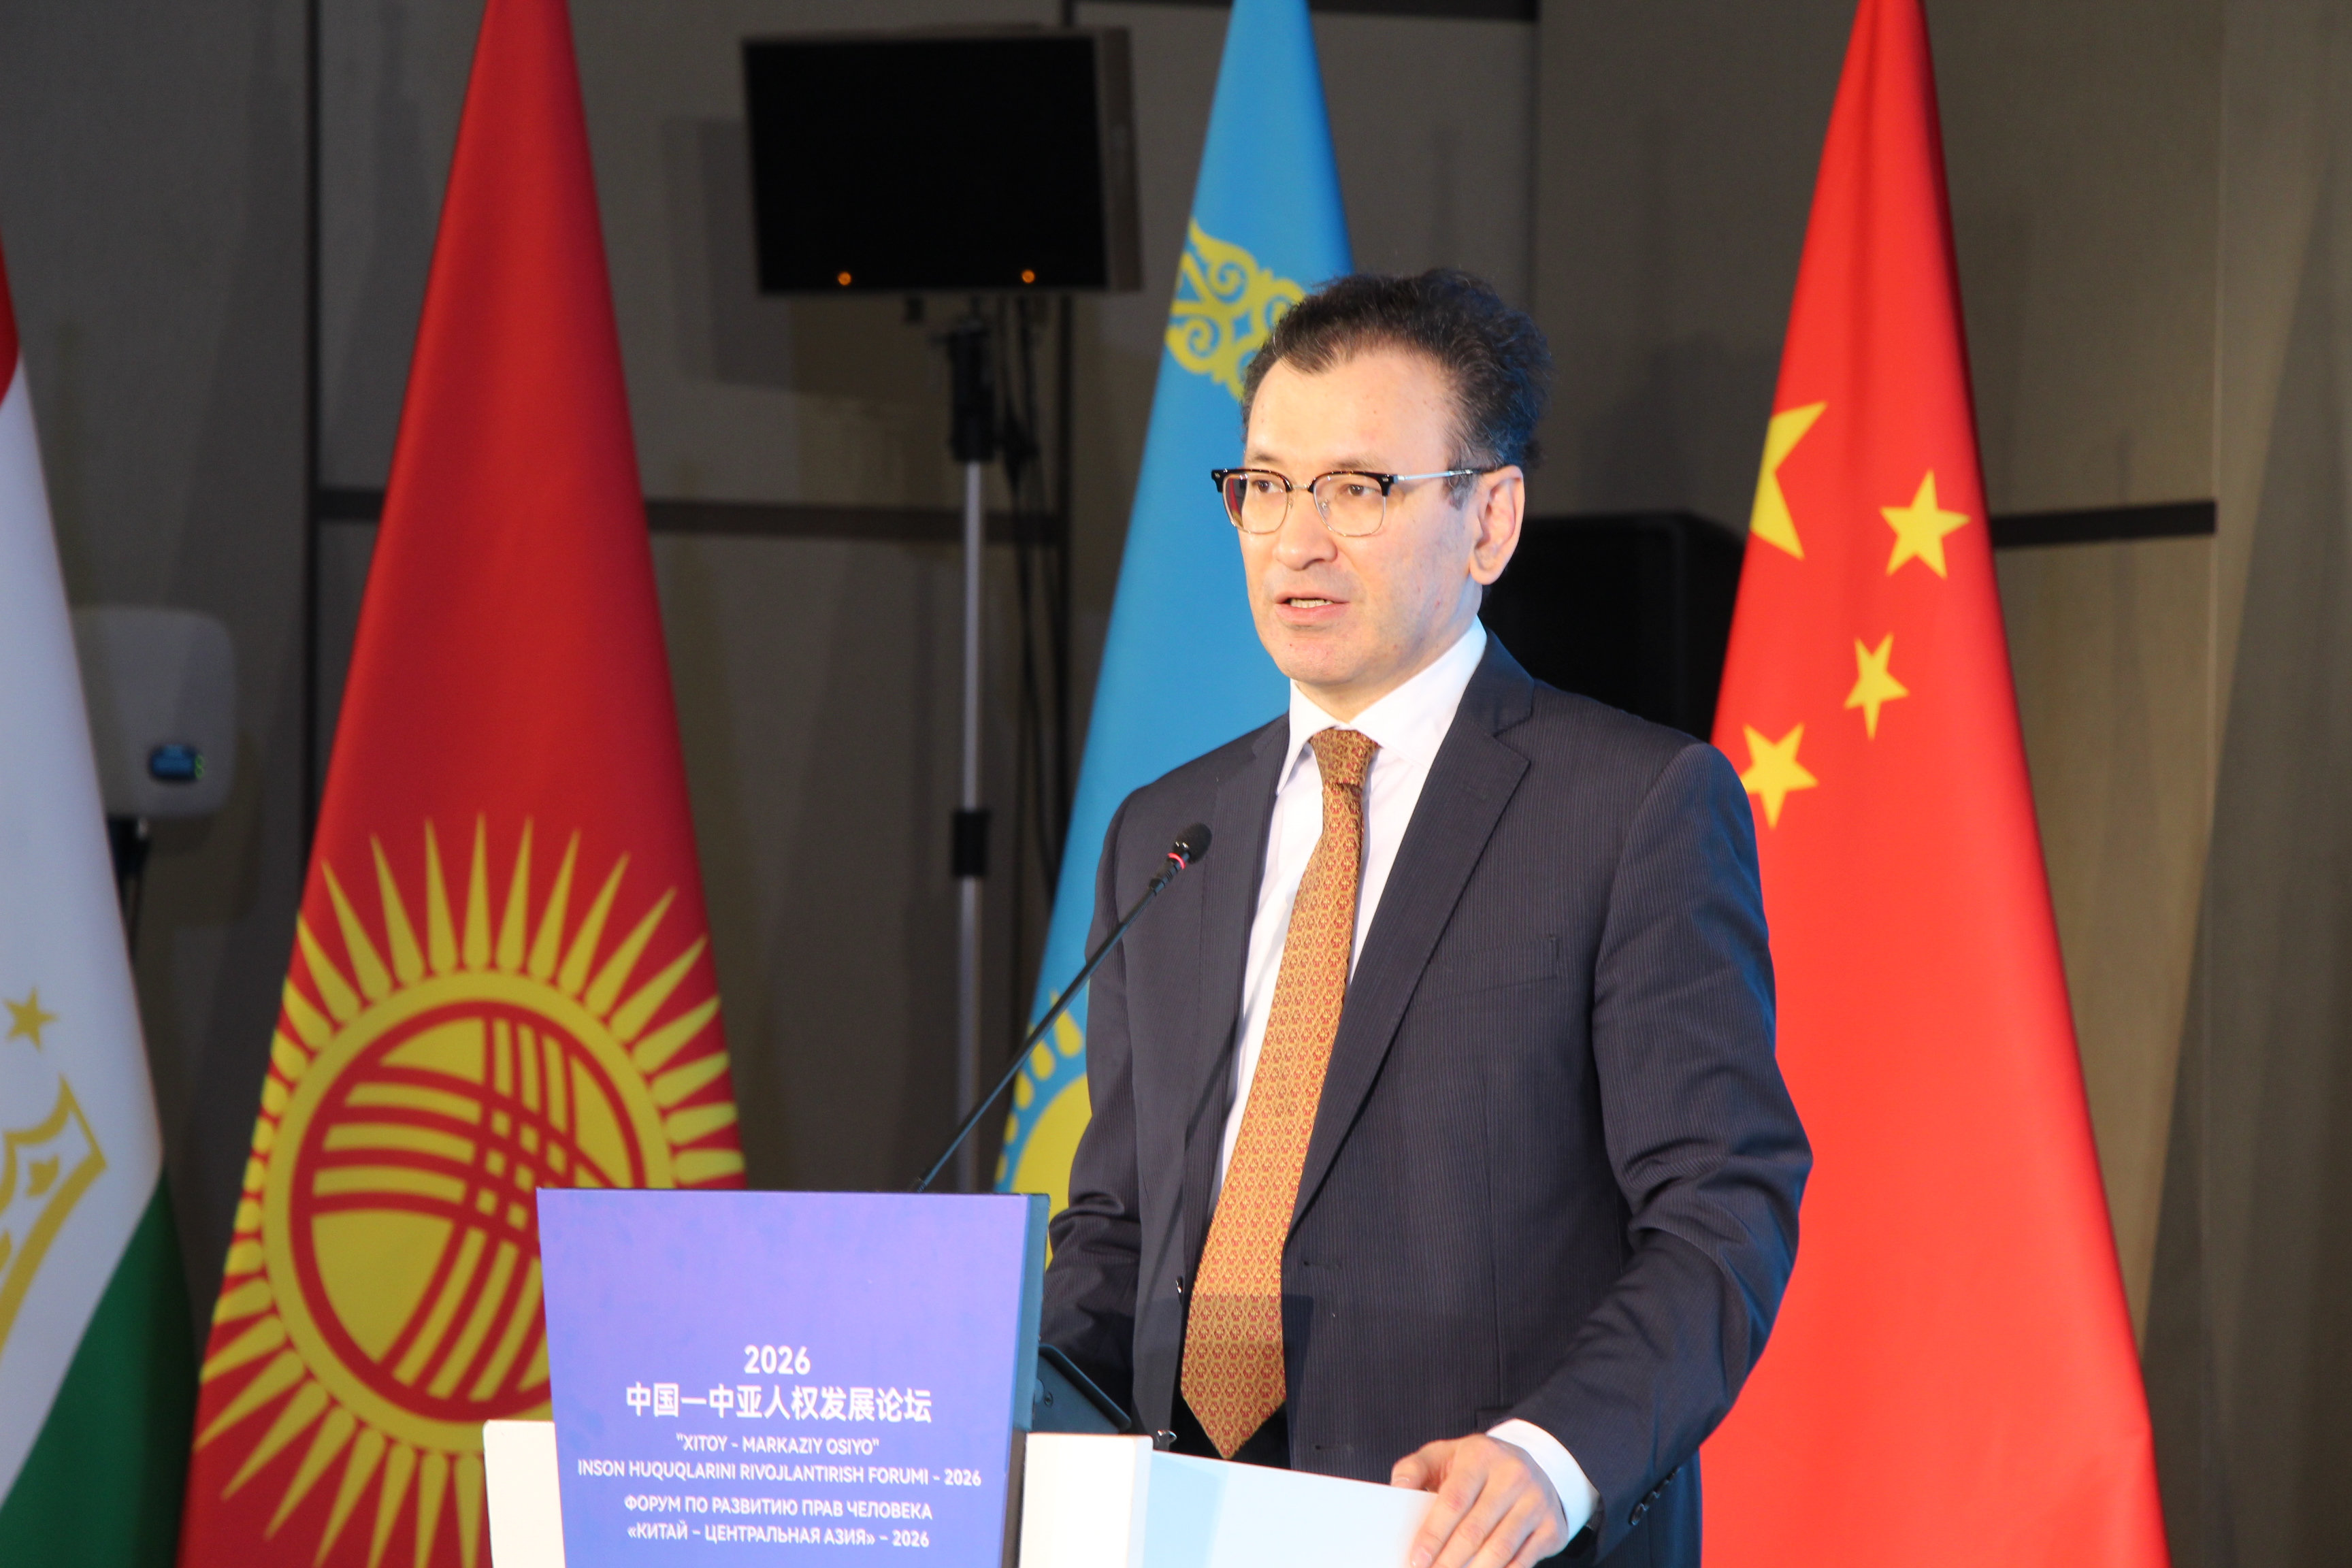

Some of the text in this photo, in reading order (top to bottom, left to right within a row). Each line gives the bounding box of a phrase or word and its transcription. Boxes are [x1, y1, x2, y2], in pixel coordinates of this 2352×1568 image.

[743, 1345, 811, 1375] 2026
[676, 1433, 728, 1452] "XITOY
[742, 1436, 823, 1454] MARKAZIY
[826, 1437, 879, 1456] OSIYO"
[577, 1458, 625, 1477] INSON
[628, 1460, 736, 1482] HUQUQLARINI
[740, 1463, 864, 1483] RIVOJLANTIRISH
[868, 1467, 929, 1485] FORUMI
[943, 1468, 982, 1487] 2026
[624, 1494, 933, 1520] ФОРУМ ПО РАЗВИТИЮ ПРАВ ЧЕЛОВЕКА
[627, 1519, 688, 1540] «КИТАЙ
[704, 1524, 821, 1545] ЦЕНТРАЛЬНАЯ
[823, 1528, 876, 1546] АЗИЯ»
[892, 1529, 930, 1548] 2026
